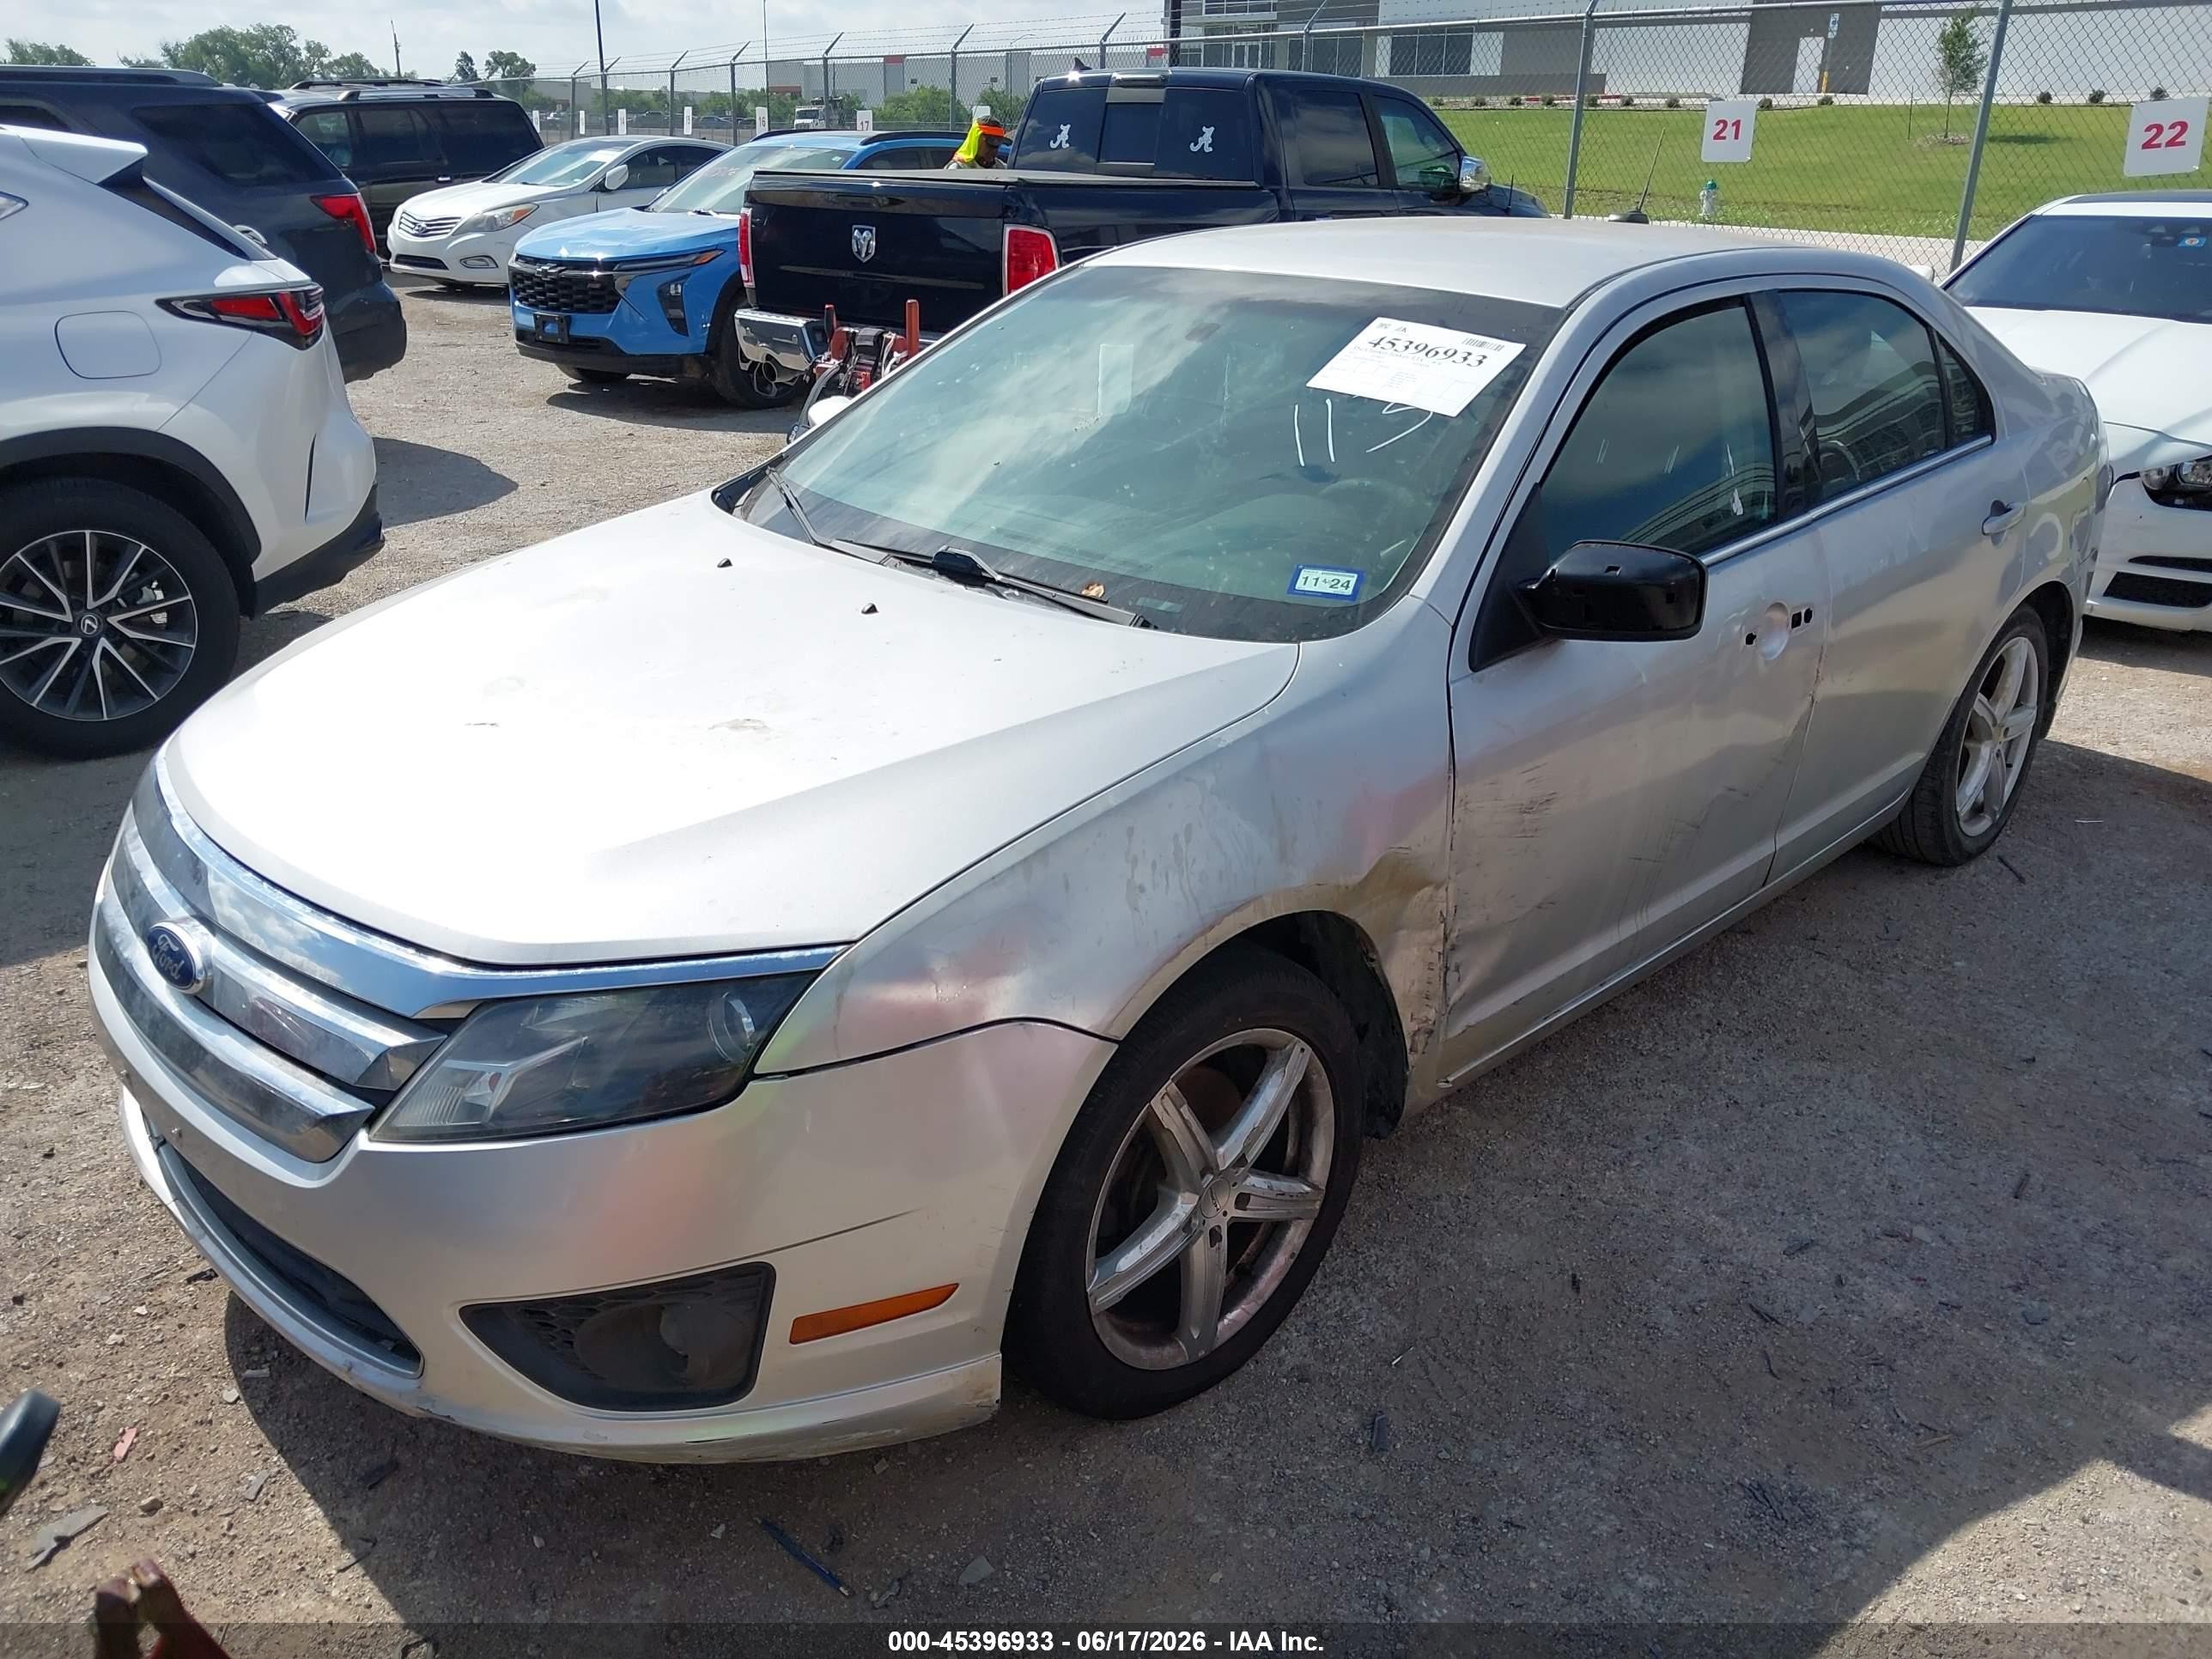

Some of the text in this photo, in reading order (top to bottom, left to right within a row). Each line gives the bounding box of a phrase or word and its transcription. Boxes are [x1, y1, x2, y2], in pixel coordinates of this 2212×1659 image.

[758, 117, 766, 128] 16
[860, 120, 870, 131] 17
[1712, 118, 1741, 141] 21
[2141, 120, 2189, 150] 22
[1368, 336, 1488, 368] 45396933
[151, 933, 185, 981] Ford
